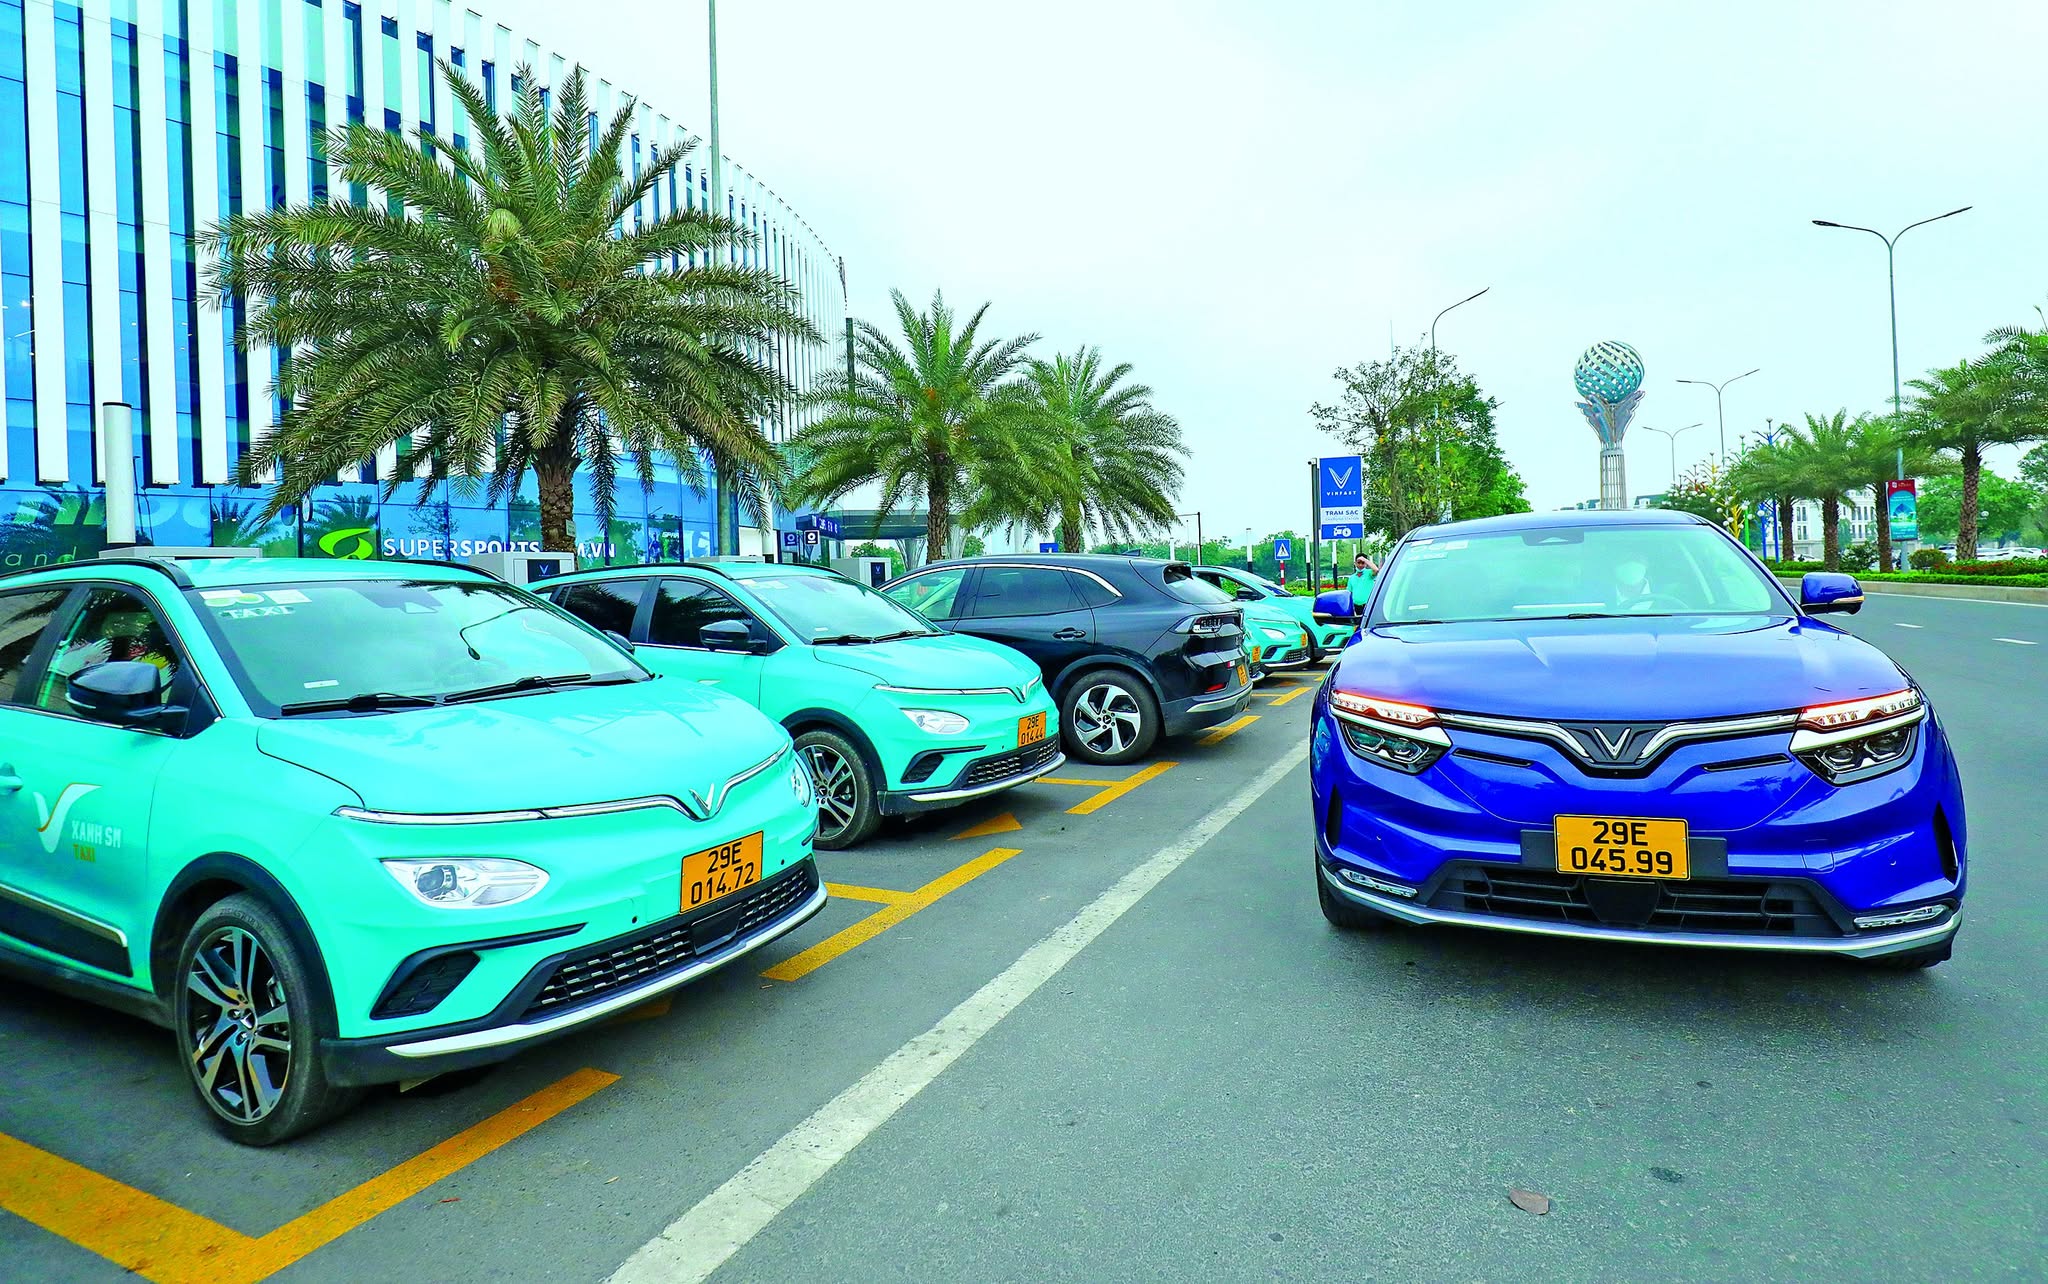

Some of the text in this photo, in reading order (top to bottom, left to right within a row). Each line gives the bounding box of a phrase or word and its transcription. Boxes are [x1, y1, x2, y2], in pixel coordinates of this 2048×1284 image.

[220, 605, 296, 619] TAXI
[72, 820, 122, 848] XANH SM
[1593, 820, 1648, 846] 29E
[707, 841, 742, 874] 29E
[1571, 847, 1673, 874] 045.99
[690, 861, 754, 905] 014.72
